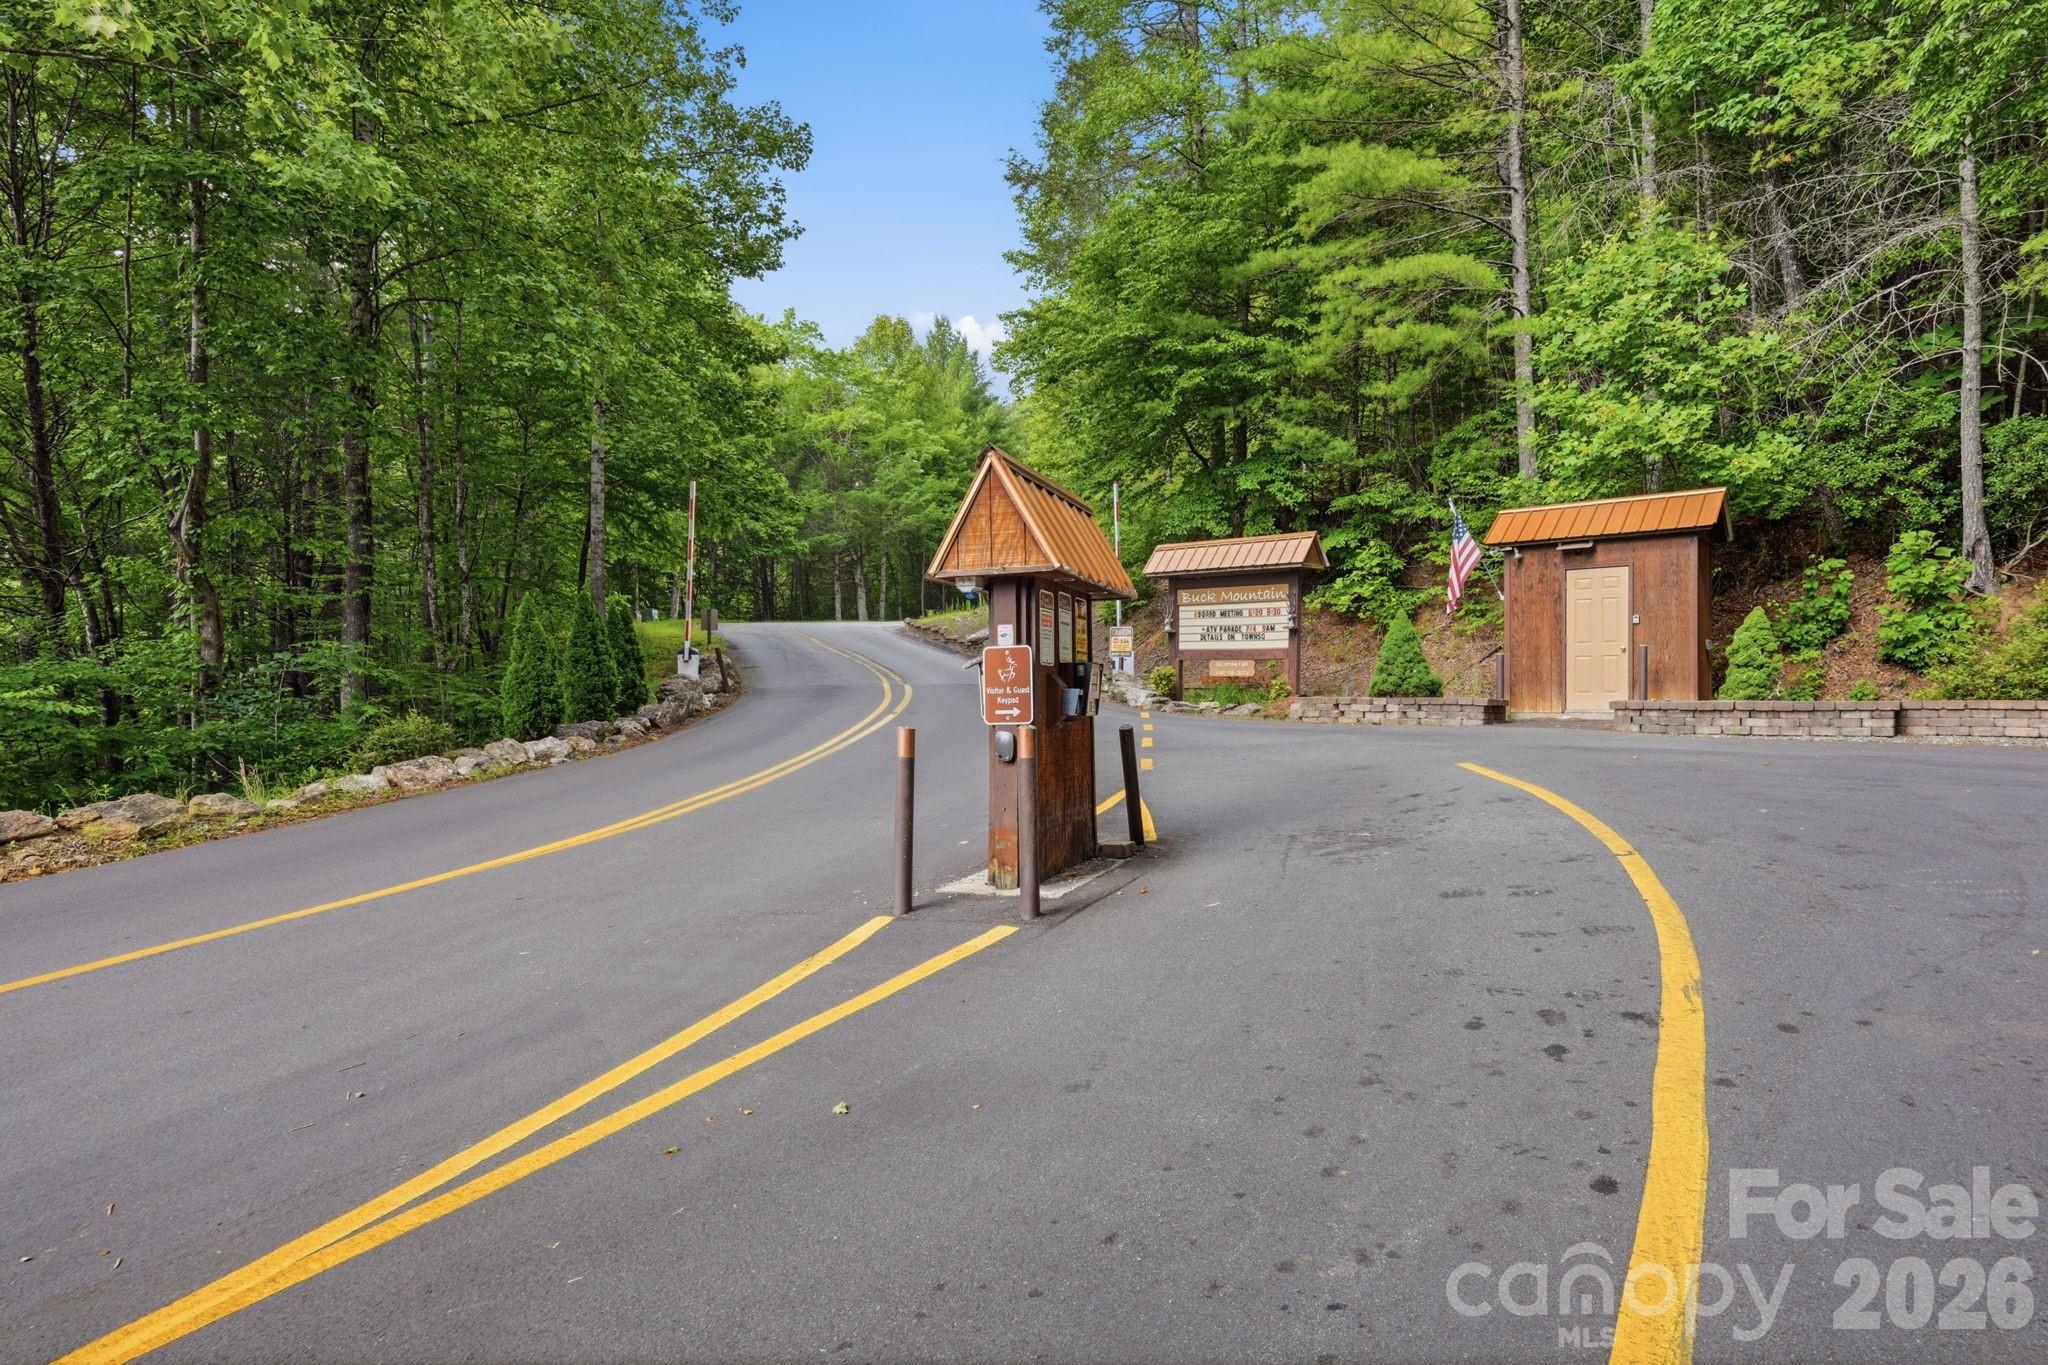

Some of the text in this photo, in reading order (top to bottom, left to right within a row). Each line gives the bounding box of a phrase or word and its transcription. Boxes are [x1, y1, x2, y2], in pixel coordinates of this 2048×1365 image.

[1181, 587, 1287, 603] Buck Mountain
[1198, 609, 1216, 618] BOARD
[1220, 609, 1244, 617] MEETING
[1200, 633, 1223, 641] DETAILS
[1013, 686, 1030, 694] Guest
